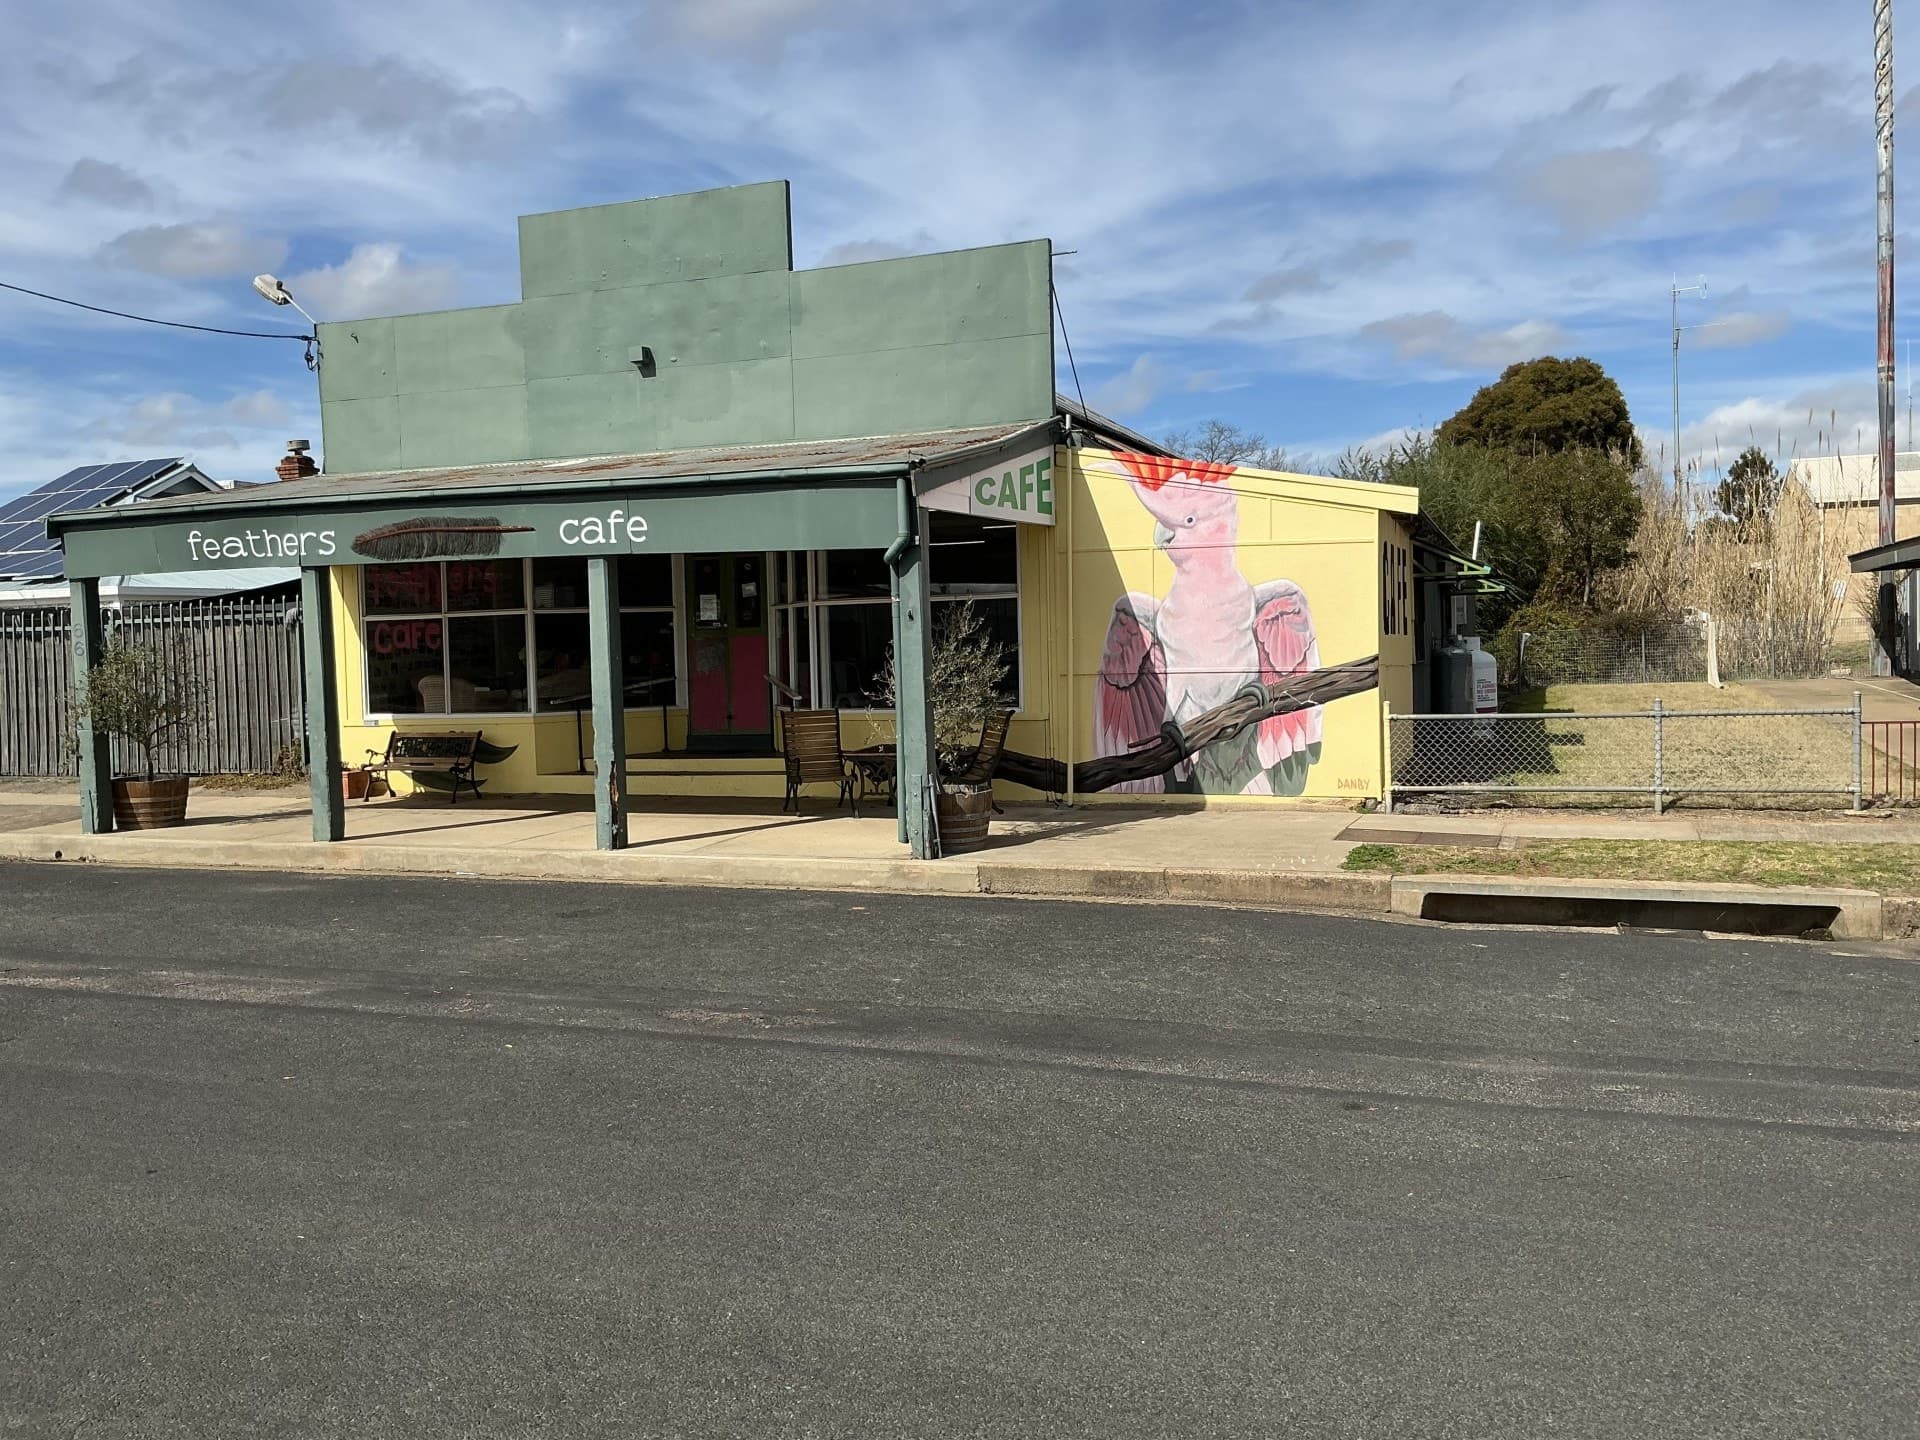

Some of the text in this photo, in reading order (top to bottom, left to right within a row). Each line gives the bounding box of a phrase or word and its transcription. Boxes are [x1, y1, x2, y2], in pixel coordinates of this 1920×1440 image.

[975, 457, 1053, 514] CAFE
[187, 509, 648, 560] feathers cafe
[1383, 541, 1408, 635] CAFE
[1337, 777, 1370, 790] DANBY
